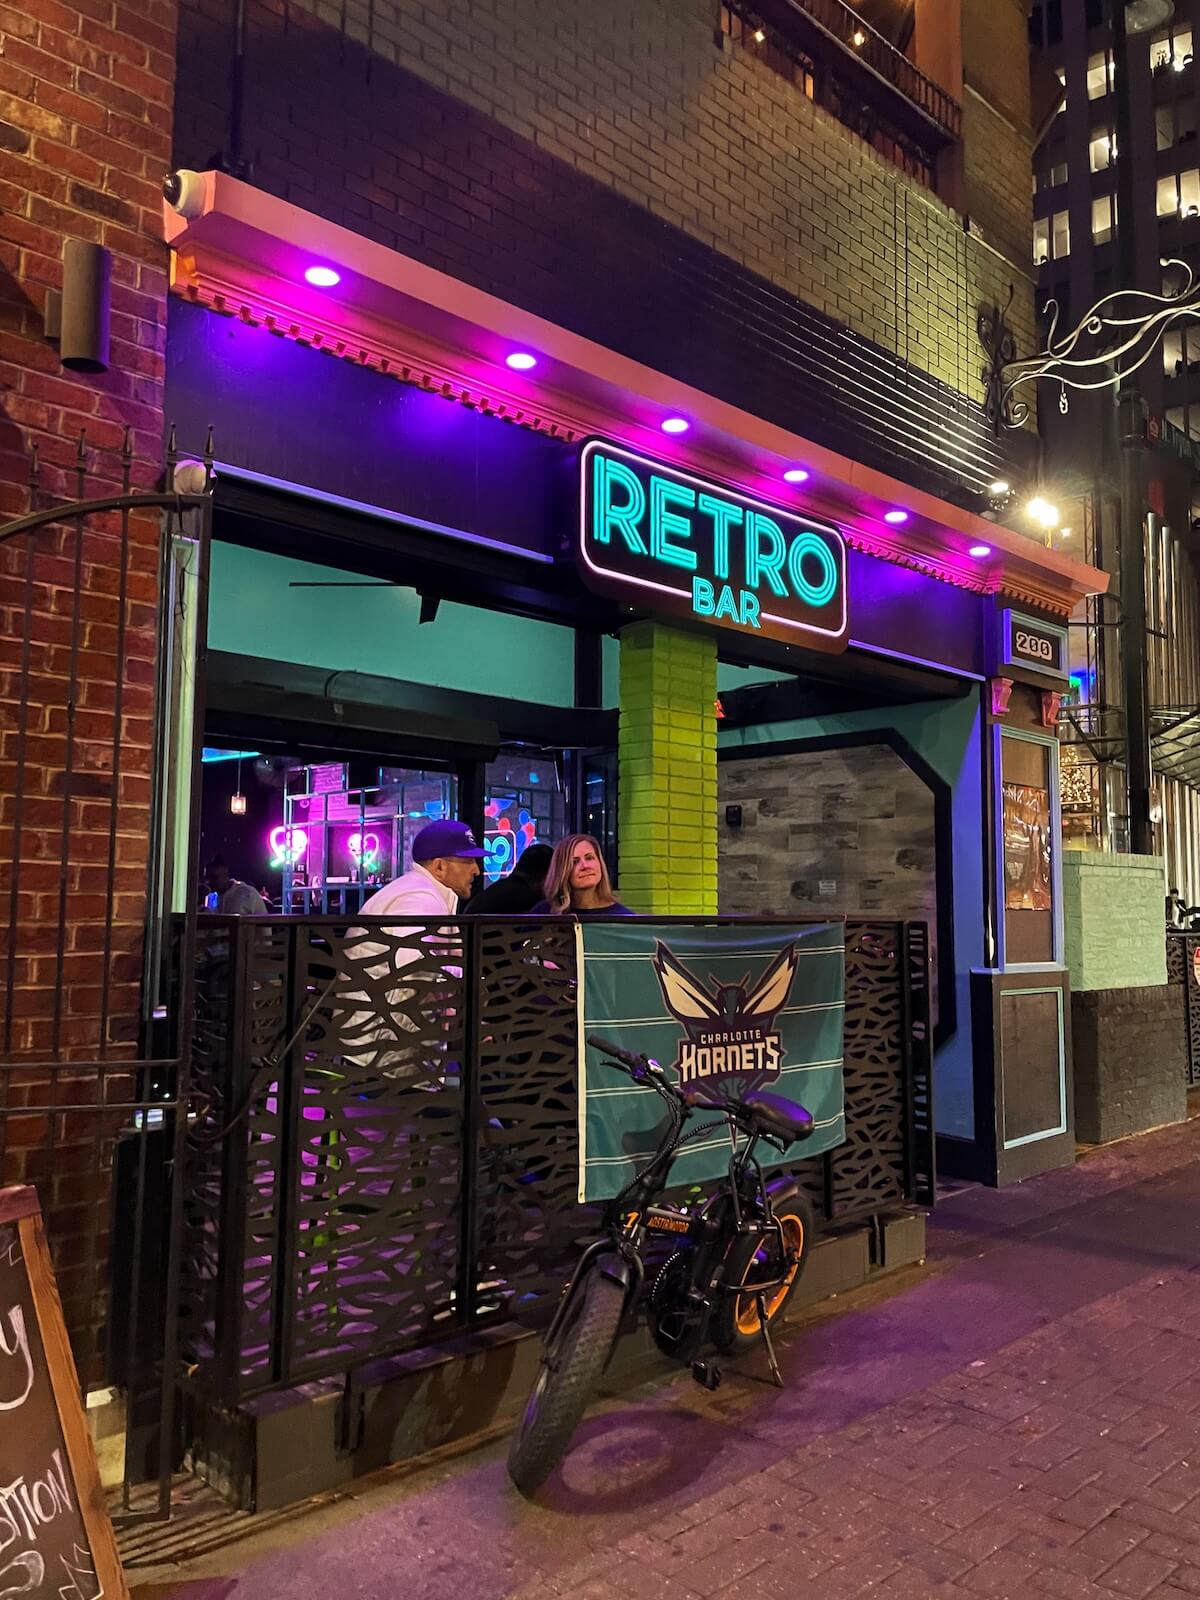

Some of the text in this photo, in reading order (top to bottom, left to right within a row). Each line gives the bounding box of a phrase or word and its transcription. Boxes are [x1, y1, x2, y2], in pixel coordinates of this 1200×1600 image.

[592, 454, 837, 607] RETRO
[692, 575, 762, 629] BAR
[1016, 631, 1052, 661] 200
[680, 1035, 780, 1082] HORNETS
[700, 1029, 761, 1044] CHARLOTTE
